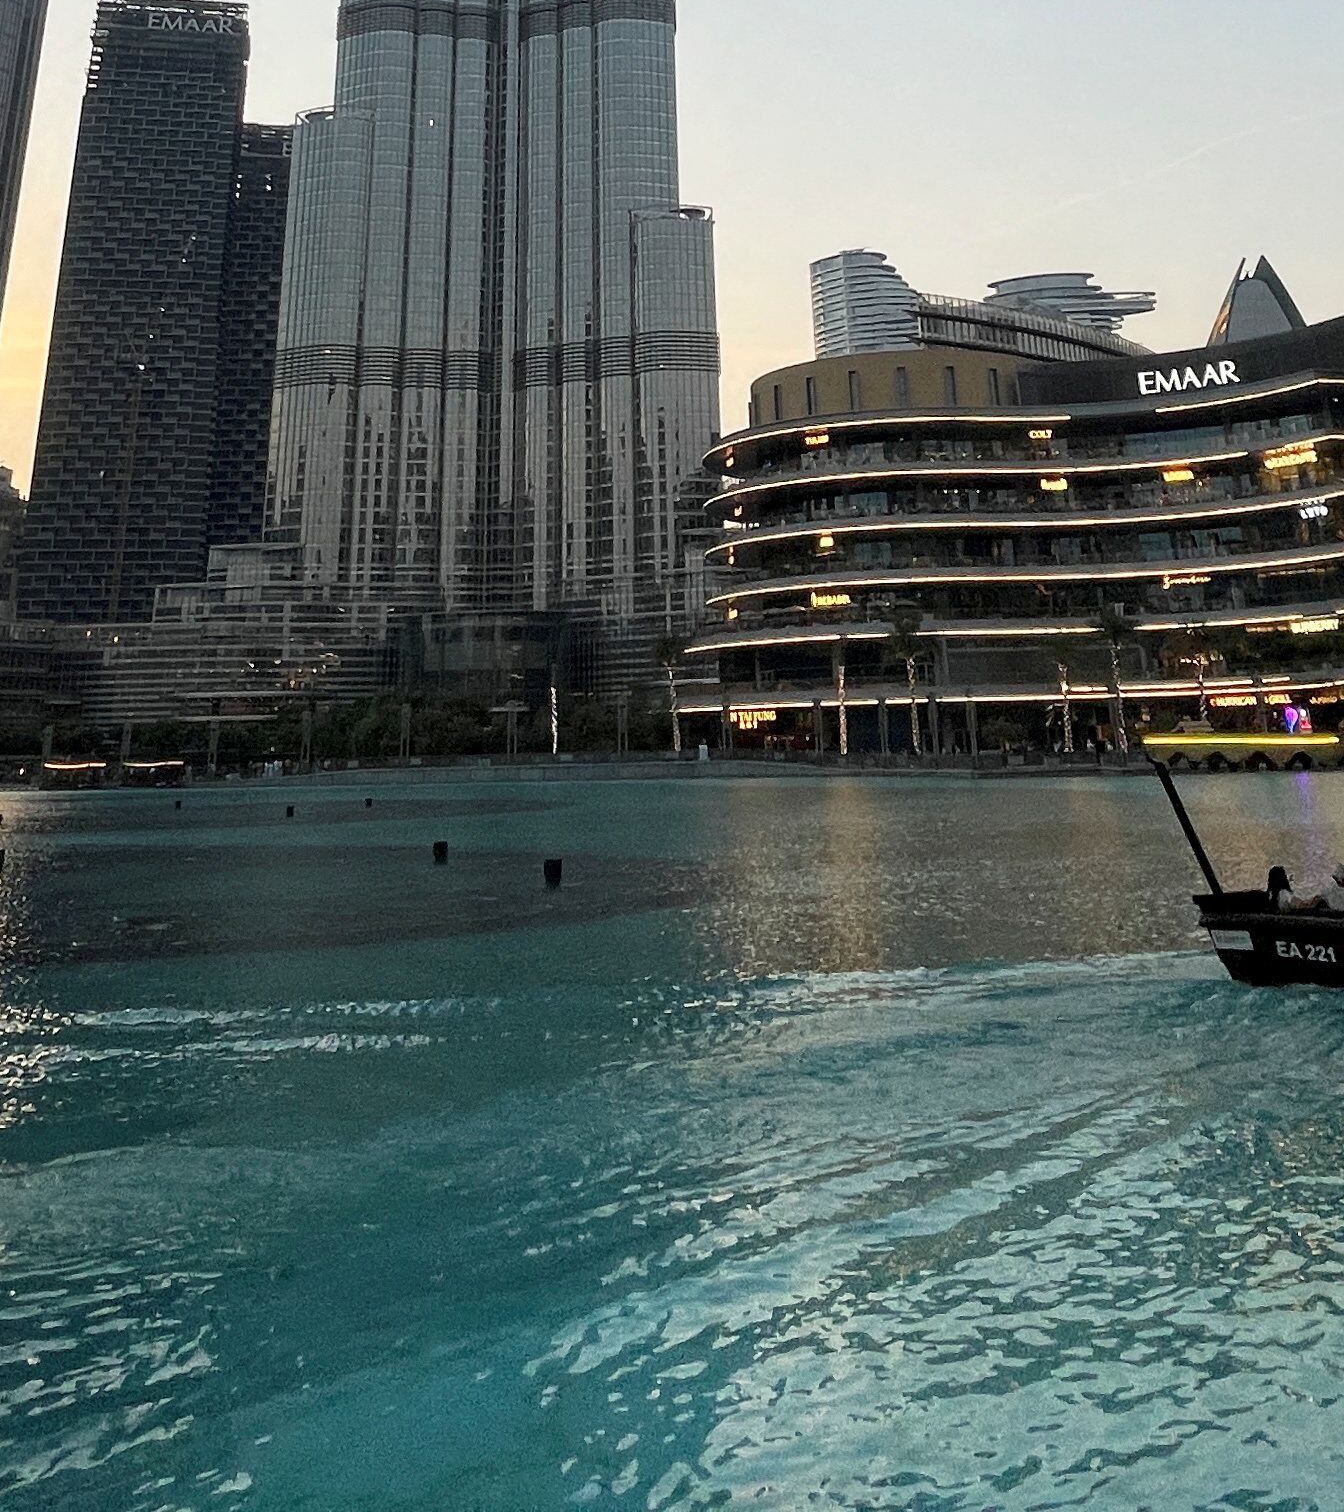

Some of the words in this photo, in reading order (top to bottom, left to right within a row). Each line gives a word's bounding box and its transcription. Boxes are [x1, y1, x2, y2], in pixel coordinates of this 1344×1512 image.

[147, 13, 236, 35] EMAAR
[1137, 360, 1241, 395] EMAAR
[1276, 941, 1303, 958] EA
[1305, 944, 1337, 963] 221
